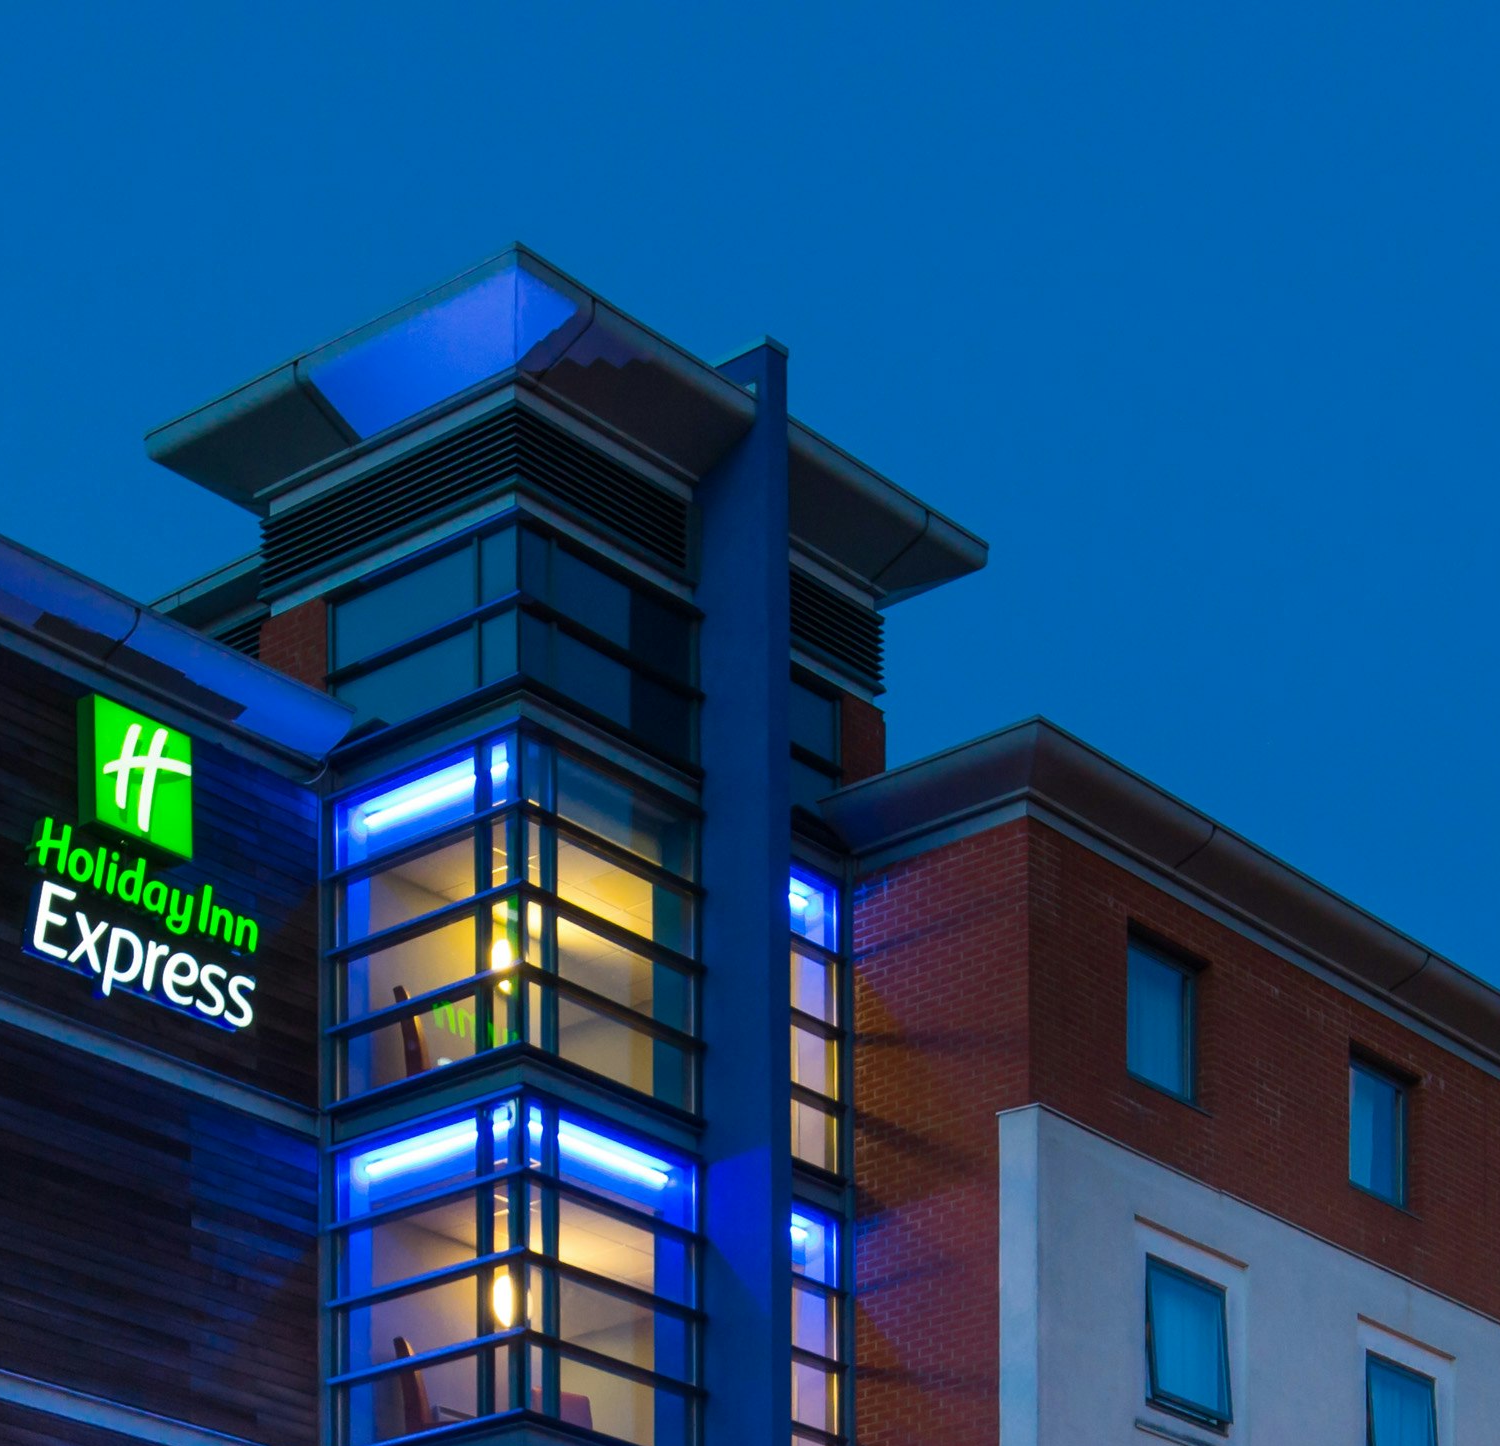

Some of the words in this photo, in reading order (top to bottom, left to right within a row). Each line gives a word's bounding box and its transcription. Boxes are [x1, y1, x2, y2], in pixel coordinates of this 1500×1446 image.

[32, 880, 256, 1028] Express
[35, 817, 195, 935] Holiday
[197, 884, 259, 953] Inn
